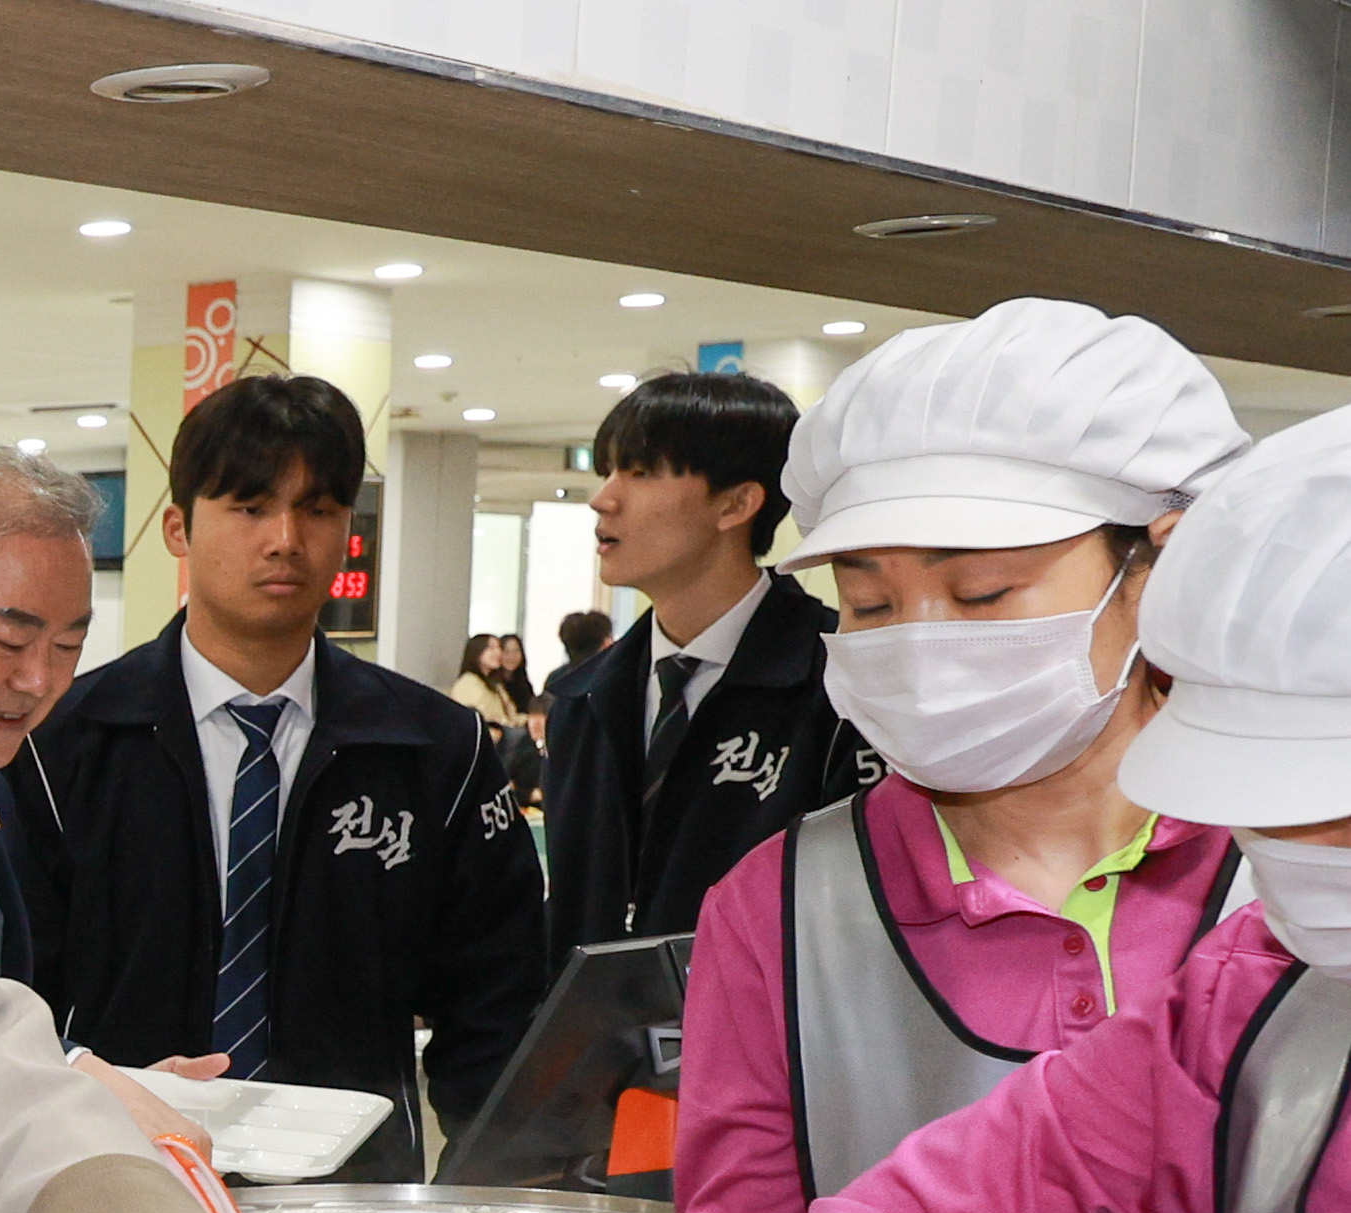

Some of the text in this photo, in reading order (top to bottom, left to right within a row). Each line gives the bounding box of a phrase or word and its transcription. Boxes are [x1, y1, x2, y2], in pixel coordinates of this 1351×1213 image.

[710, 731, 790, 801] 전심
[856, 748, 893, 785] 5
[327, 795, 414, 871] 전심
